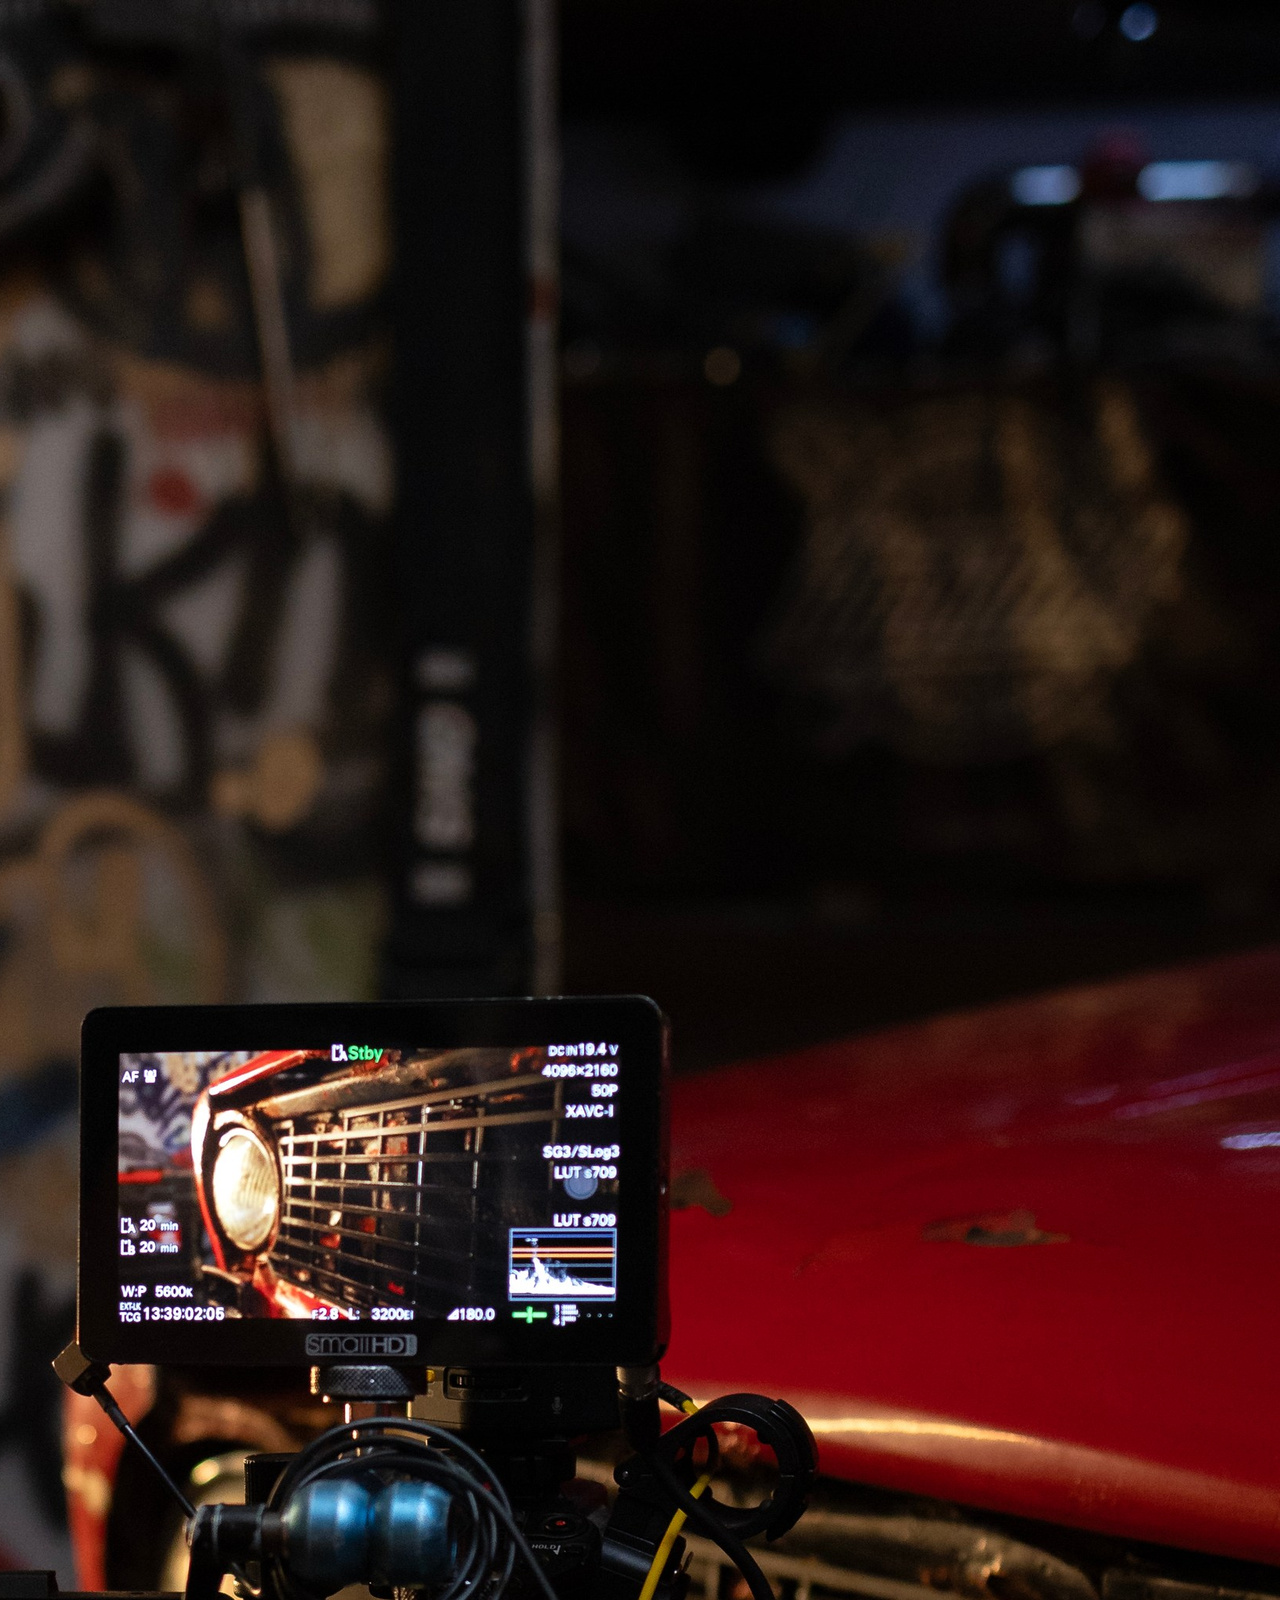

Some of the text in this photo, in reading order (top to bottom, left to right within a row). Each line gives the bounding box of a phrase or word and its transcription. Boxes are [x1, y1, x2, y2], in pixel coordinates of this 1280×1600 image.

[348, 1045, 383, 1063] Stby
[608, 1044, 619, 1056] V
[121, 1070, 140, 1083] AF
[591, 1084, 618, 1097] 50P
[565, 1104, 614, 1118] XAVC-I
[542, 1145, 620, 1160] SG3/SLog3
[553, 1165, 618, 1179] LUT s709
[139, 1218, 156, 1231] 20
[160, 1221, 179, 1231] min
[552, 1213, 617, 1227] LUT s709
[139, 1240, 156, 1253] 20
[160, 1243, 179, 1253] min
[120, 1285, 147, 1298] W:P
[119, 1311, 141, 1322] TCG
